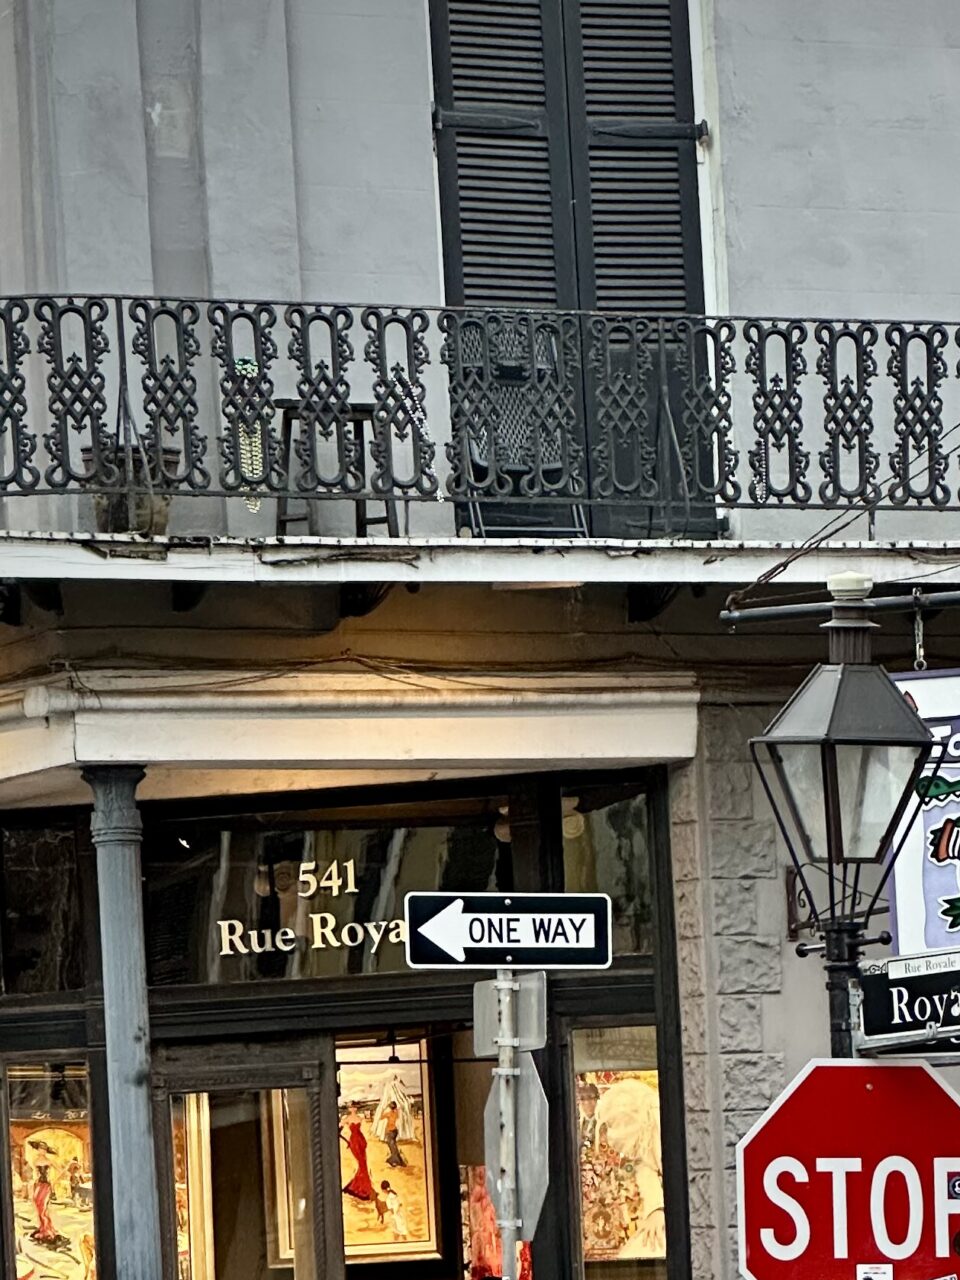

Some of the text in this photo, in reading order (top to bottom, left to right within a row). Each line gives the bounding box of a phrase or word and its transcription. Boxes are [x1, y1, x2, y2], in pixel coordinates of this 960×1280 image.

[298, 859, 359, 897] 541
[217, 912, 406, 955] Rue Roya
[469, 917, 587, 944] ONE WAY
[904, 957, 956, 974] Rue Royale
